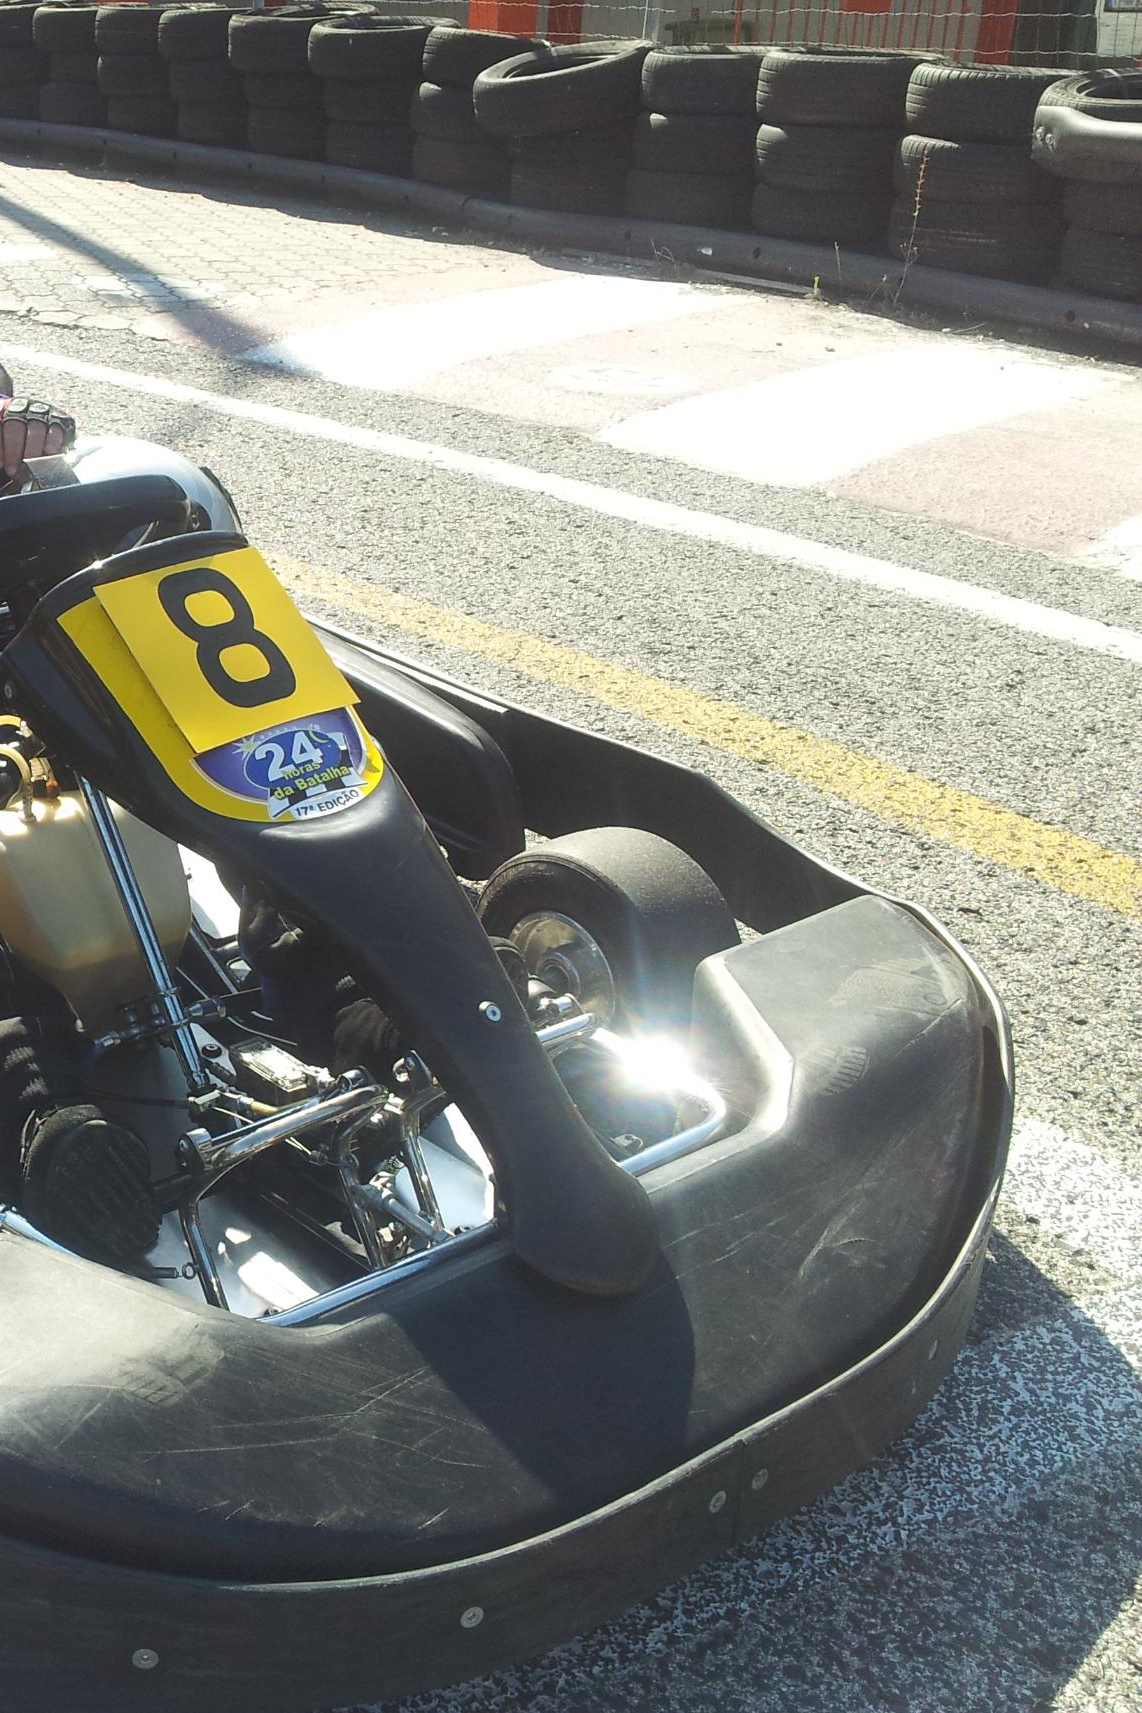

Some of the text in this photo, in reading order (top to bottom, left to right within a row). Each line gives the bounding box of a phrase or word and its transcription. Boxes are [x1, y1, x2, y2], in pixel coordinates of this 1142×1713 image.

[157, 567, 297, 708] 8
[254, 731, 324, 783] 24
[273, 765, 350, 800] da Batalha
[318, 789, 359, 812] EDIÇÃO
